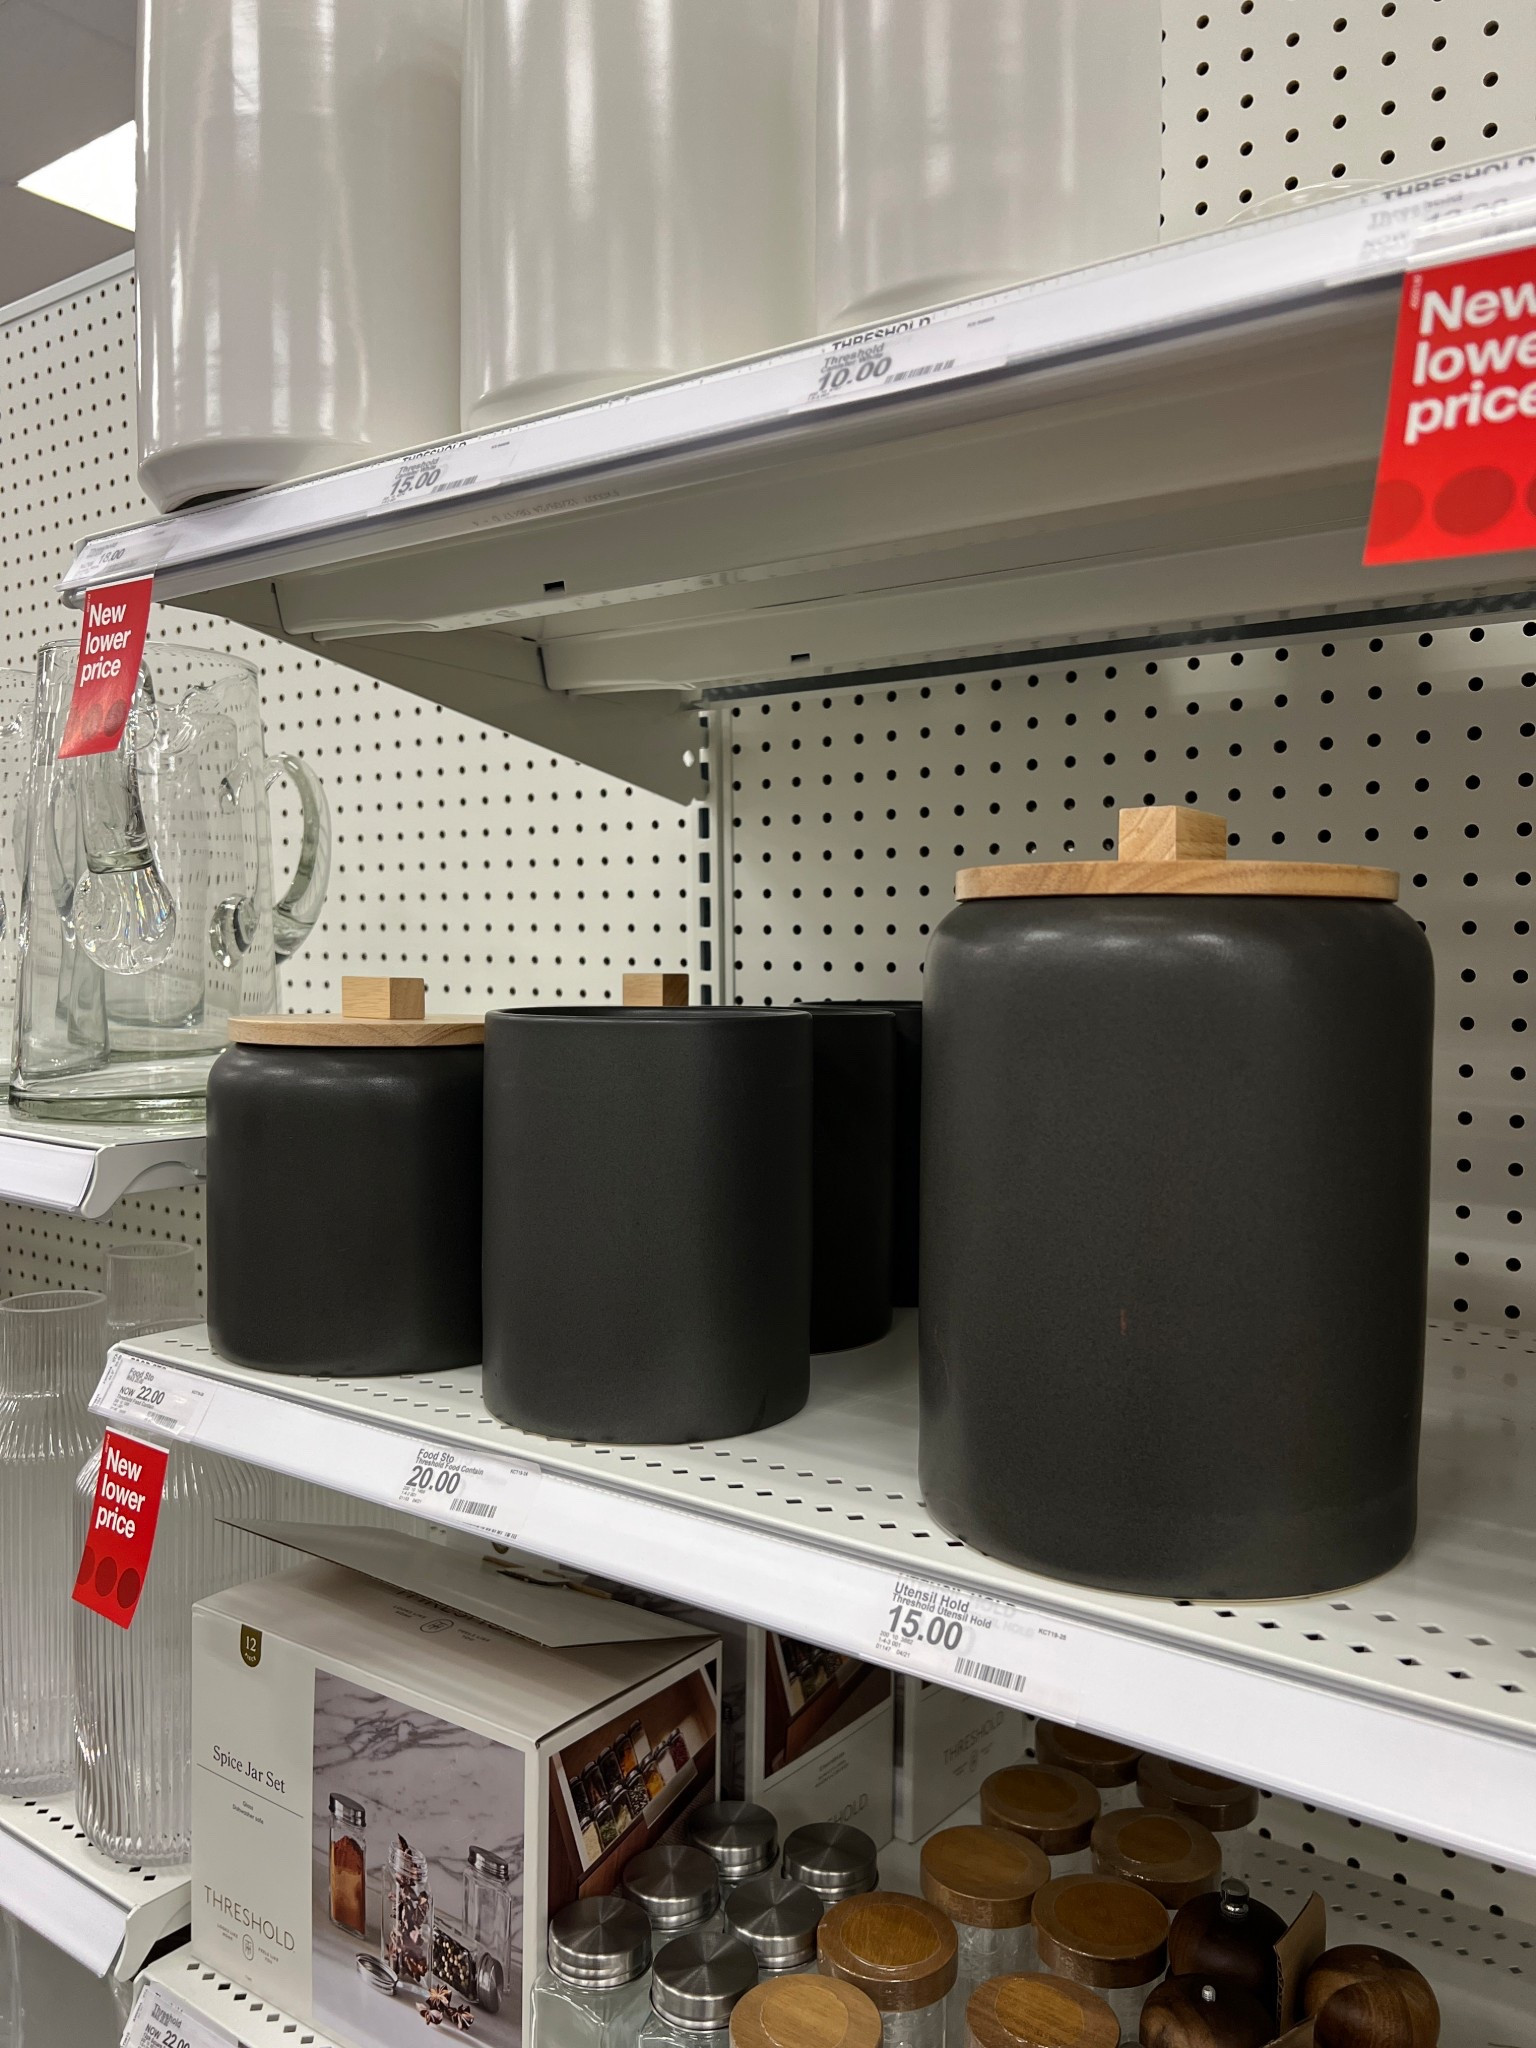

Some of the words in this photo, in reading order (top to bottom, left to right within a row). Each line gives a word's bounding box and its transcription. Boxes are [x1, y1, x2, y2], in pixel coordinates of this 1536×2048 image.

[1419, 281, 1536, 336] New
[823, 343, 885, 368] Threshold
[817, 356, 893, 391] 10.00
[390, 468, 442, 497] 15.00
[88, 603, 127, 628] New
[85, 629, 132, 655] lower
[79, 656, 122, 688] price
[128, 1367, 143, 1380] Food
[144, 1371, 155, 1382] Sto
[119, 1386, 137, 1397] NOW
[136, 1385, 166, 1405] 22.00
[106, 1446, 143, 1482] New
[415, 1456, 444, 1469] Threshold
[444, 1462, 460, 1473] Food
[460, 1465, 484, 1476] Contain
[417, 1448, 440, 1461] Food
[440, 1452, 455, 1464] Sto
[101, 1473, 146, 1512] lower
[406, 1465, 461, 1494] 20.00
[94, 1505, 136, 1539] price
[892, 1592, 935, 1613] Threshold
[937, 1605, 969, 1622] Utensil
[970, 1615, 992, 1629] Hold
[894, 1581, 938, 1604] Utensil
[939, 1594, 970, 1613] Hold
[888, 1604, 963, 1651] 15.00
[245, 1635, 257, 1653] 12
[943, 1710, 1005, 1766] THRESHOLD
[213, 1745, 243, 1773] Spice
[245, 1761, 264, 1783] Jar
[265, 1771, 286, 1794] Set
[204, 1885, 295, 1951] THRESHOLD
[144, 2023, 162, 2040] NOW
